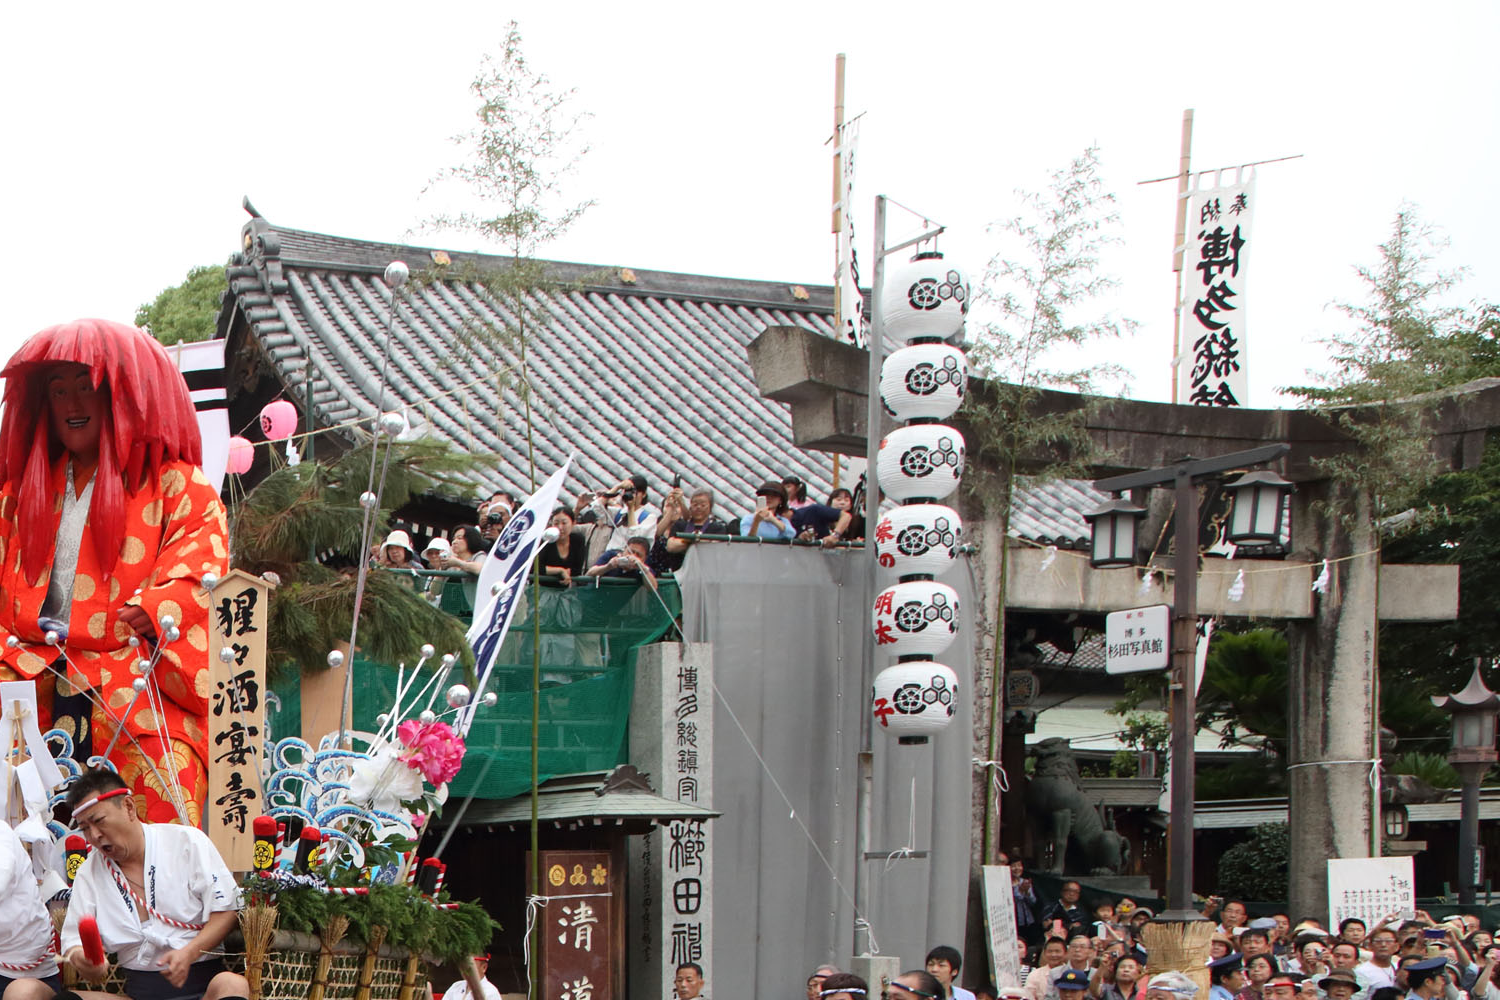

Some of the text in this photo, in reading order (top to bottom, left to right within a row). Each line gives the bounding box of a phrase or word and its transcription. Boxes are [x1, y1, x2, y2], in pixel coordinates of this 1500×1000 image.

[1108, 638, 1163, 659] 杉田写真館
